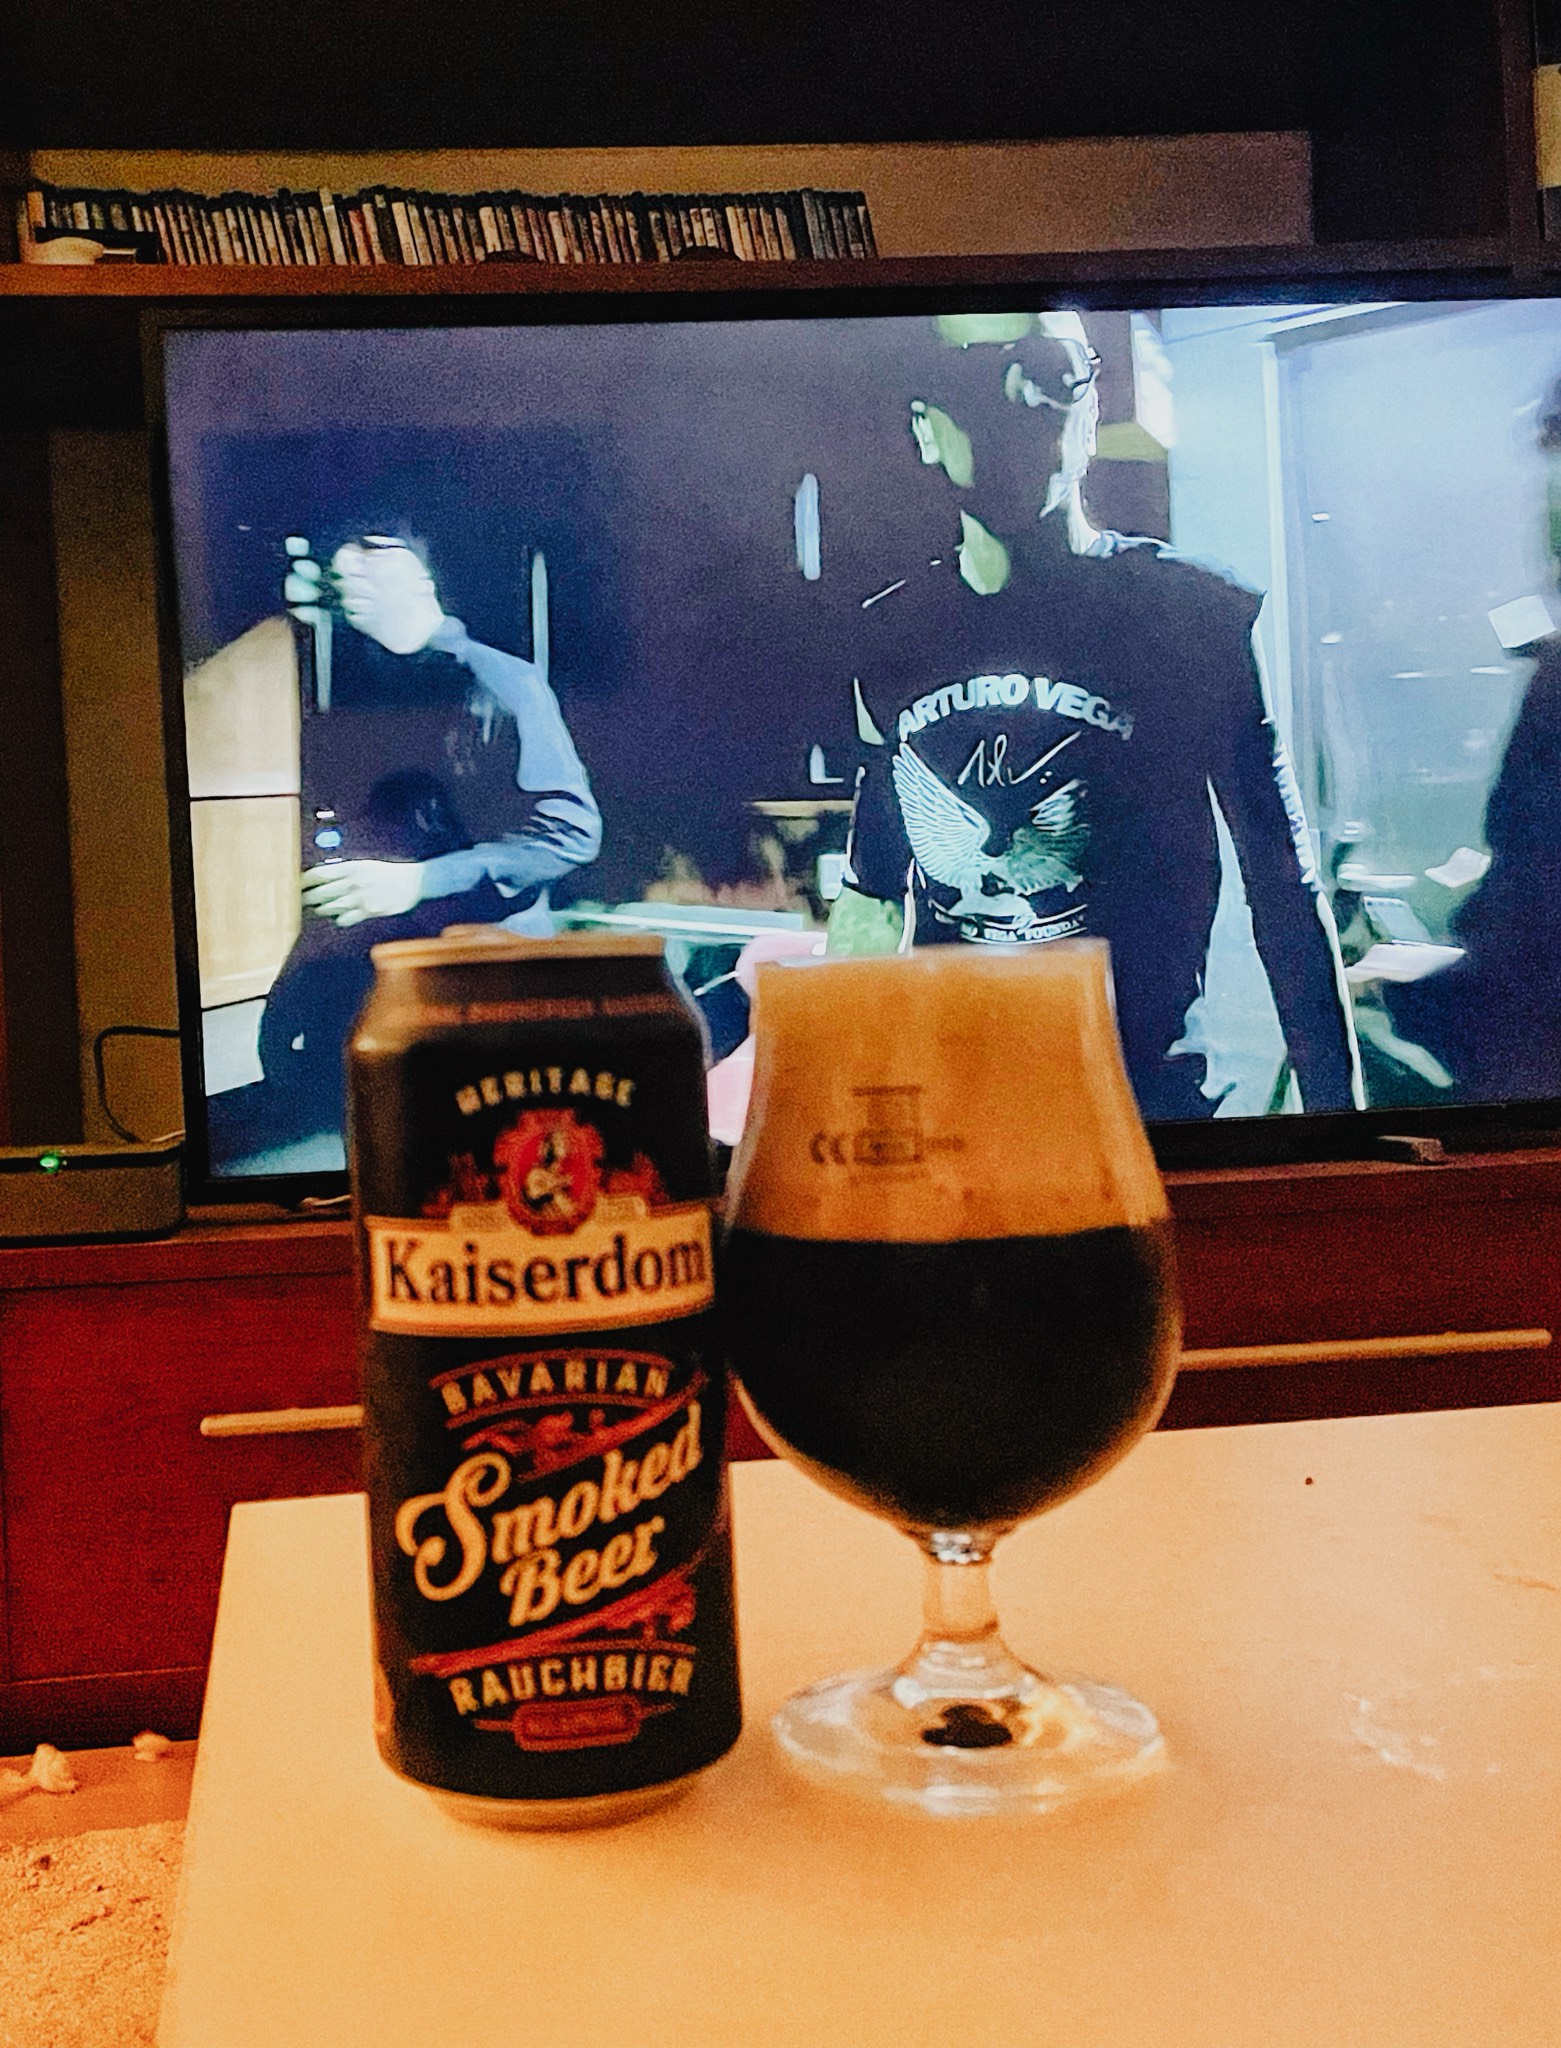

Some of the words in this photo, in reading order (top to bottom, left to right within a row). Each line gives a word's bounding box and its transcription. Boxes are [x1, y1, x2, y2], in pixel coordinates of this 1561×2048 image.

[899, 674, 1029, 742] ARTURO
[1034, 677, 1135, 741] VEGA
[455, 1066, 636, 1116] HERITAGE
[386, 1232, 707, 1307] Kaiserdom
[441, 1358, 670, 1416] BAVARIAN
[395, 1400, 704, 1601] Smoked
[500, 1515, 666, 1627] Beer
[448, 1653, 696, 1717] RAUCHBIER
